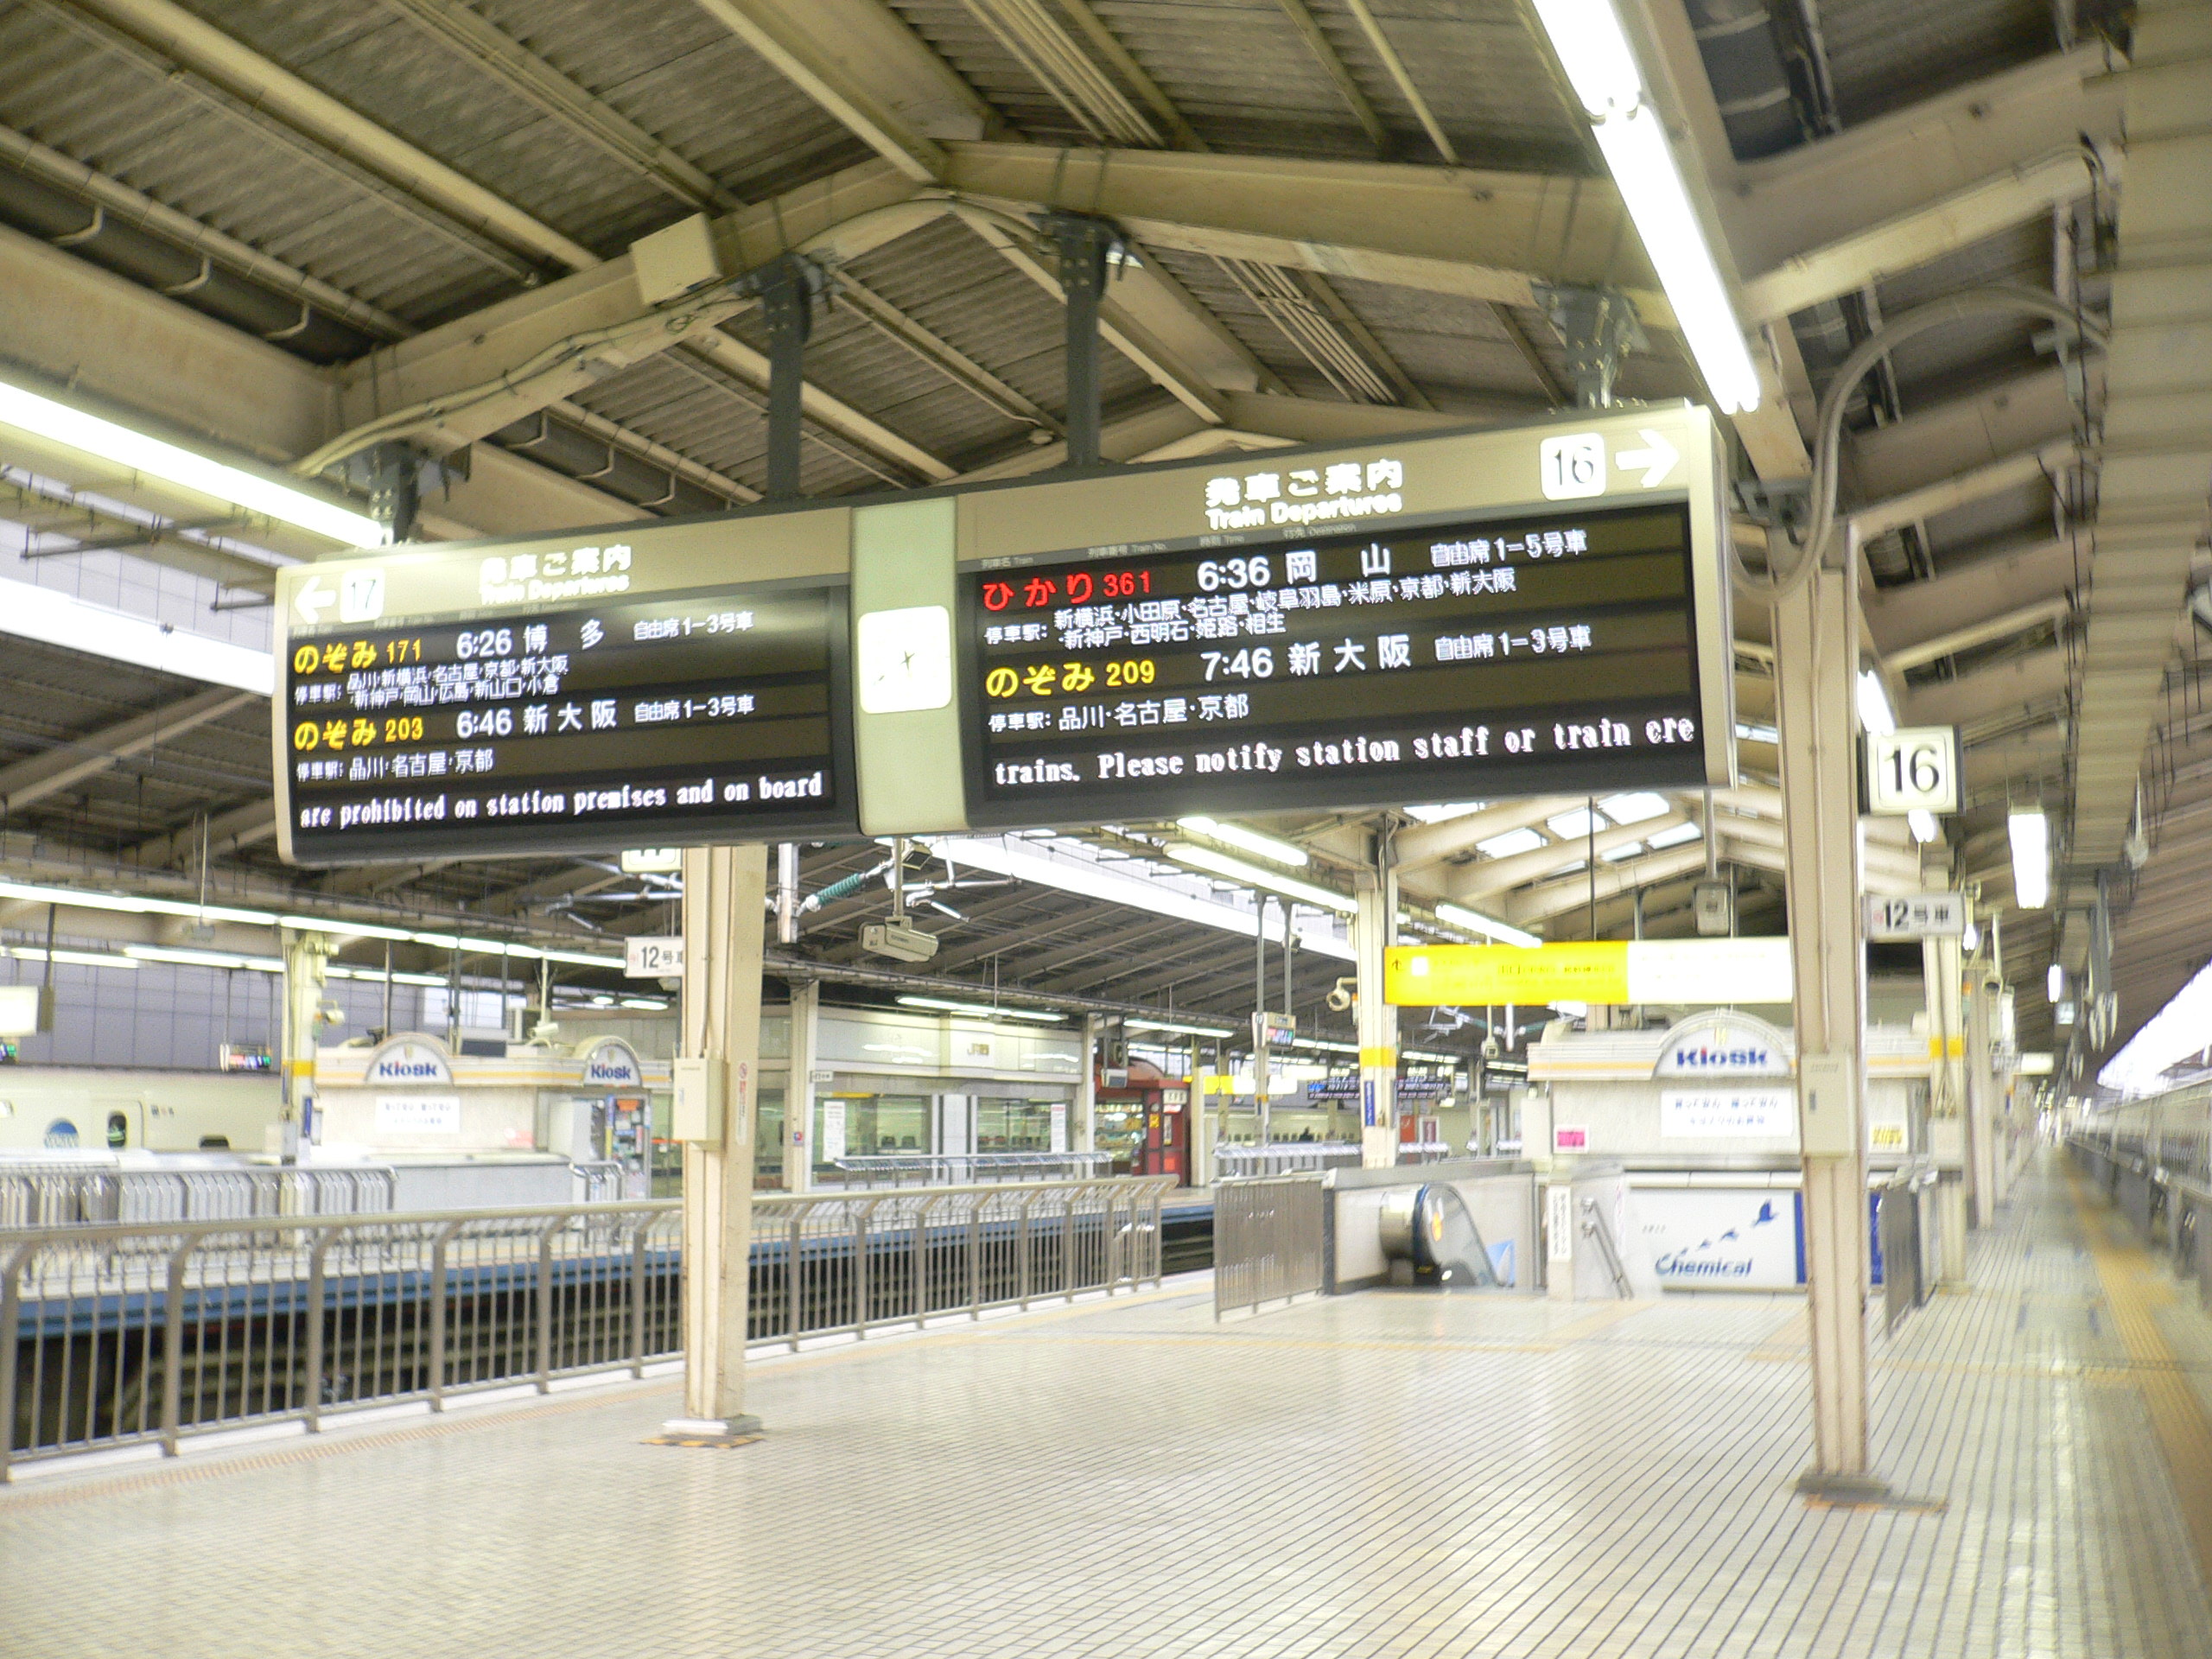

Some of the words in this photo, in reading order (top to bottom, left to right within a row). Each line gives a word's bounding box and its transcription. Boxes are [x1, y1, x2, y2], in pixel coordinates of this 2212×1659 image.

[1554, 446, 1594, 486] 16
[1205, 505, 1265, 531] Train
[1270, 493, 1403, 525] Departures
[350, 578, 377, 610] 17
[982, 572, 1094, 612] ひかり
[1103, 570, 1151, 597] 361
[1197, 555, 1271, 591] 6:36
[294, 640, 377, 675] のぞみ
[386, 638, 423, 664] 171
[456, 628, 513, 659] 6:26
[985, 662, 1095, 698] のぞみ
[1106, 659, 1155, 687] 209
[1199, 647, 1274, 683] 7:46
[1287, 634, 1412, 677] 新大阪
[294, 718, 377, 752] のぞみ
[385, 716, 424, 743] 203
[456, 708, 513, 739] 6:46
[523, 698, 618, 734] 新大阪
[995, 759, 1080, 785] trains.
[1097, 751, 1184, 779] Please
[1195, 741, 1282, 773] notify
[1295, 735, 1400, 767] station
[1412, 726, 1490, 760] staff
[1504, 728, 1536, 754] or
[1553, 717, 1631, 751] train
[1884, 745, 1940, 793] 16
[301, 805, 333, 830] are
[340, 793, 446, 830] prohibited
[454, 798, 479, 819] on
[486, 789, 566, 817] station
[574, 784, 667, 816] premises
[676, 778, 715, 805] and
[723, 782, 750, 803] on
[759, 771, 823, 800] board
[378, 1061, 437, 1077] Kiosk
[591, 1064, 632, 1079] Kiosk
[1675, 1045, 1768, 1068] Kiosk
[1656, 1254, 1753, 1276] Chemical
